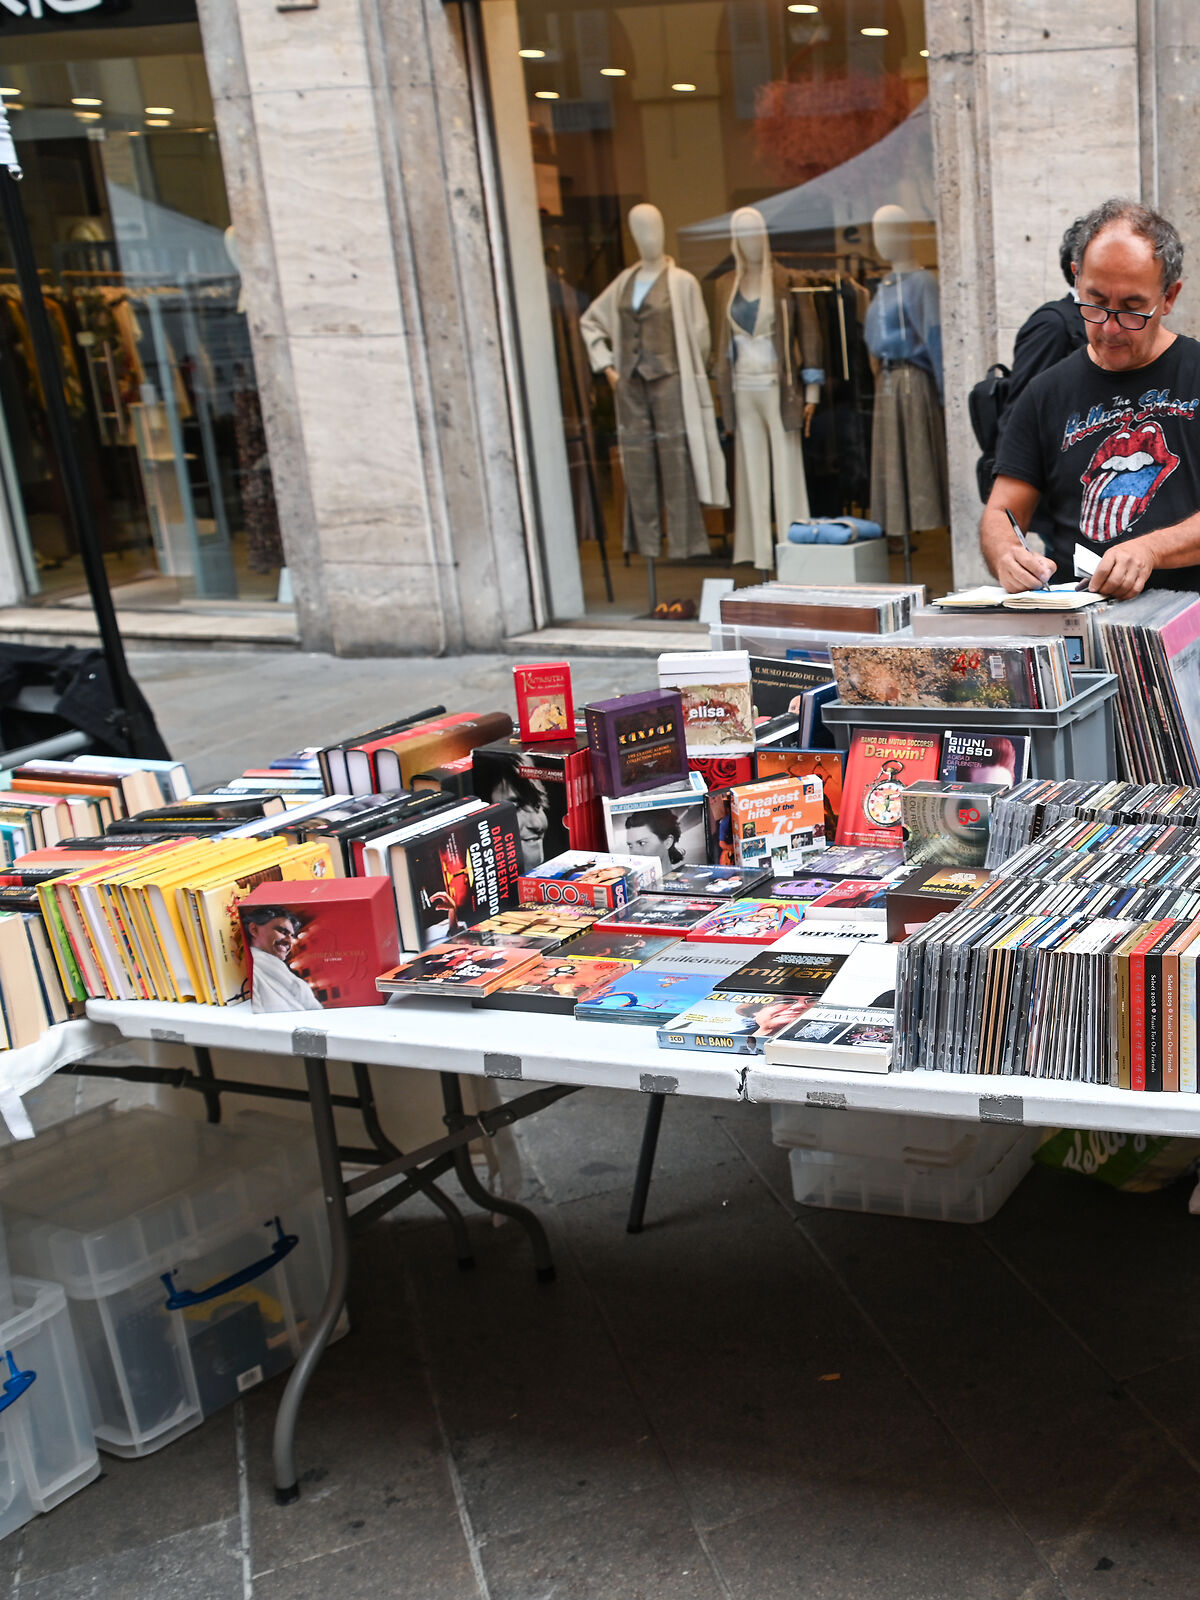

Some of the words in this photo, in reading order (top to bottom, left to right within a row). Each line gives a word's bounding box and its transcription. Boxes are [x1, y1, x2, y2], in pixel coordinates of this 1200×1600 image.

[1112, 396, 1131, 407] The
[761, 668, 781, 676] MUSEO
[781, 670, 803, 679] EGIZIO
[889, 738, 907, 746] MUTUO
[907, 739, 934, 748] SOCCORSO
[949, 737, 986, 748] GIUNI
[864, 745, 926, 761] Darwin!
[948, 746, 993, 757] RUSSO
[521, 768, 543, 776] FABRIZIO
[739, 789, 800, 810] Greatest
[909, 796, 917, 812] LOU
[748, 806, 771, 821] hits
[773, 804, 782, 813] of
[782, 802, 795, 812] the
[958, 808, 981, 825] 50
[910, 814, 920, 836] REED
[478, 820, 490, 847] UNO
[491, 826, 510, 900] DAUGHERTY
[503, 833, 520, 884] CHRISTI
[469, 842, 488, 906] CADAVERE
[483, 848, 500, 917] SPLENDIDO
[738, 966, 836, 980] millen
[704, 993, 729, 1001] AL
[728, 994, 775, 1005] BANO
[695, 1037, 707, 1046] AL
[708, 1037, 734, 1048] BANO
